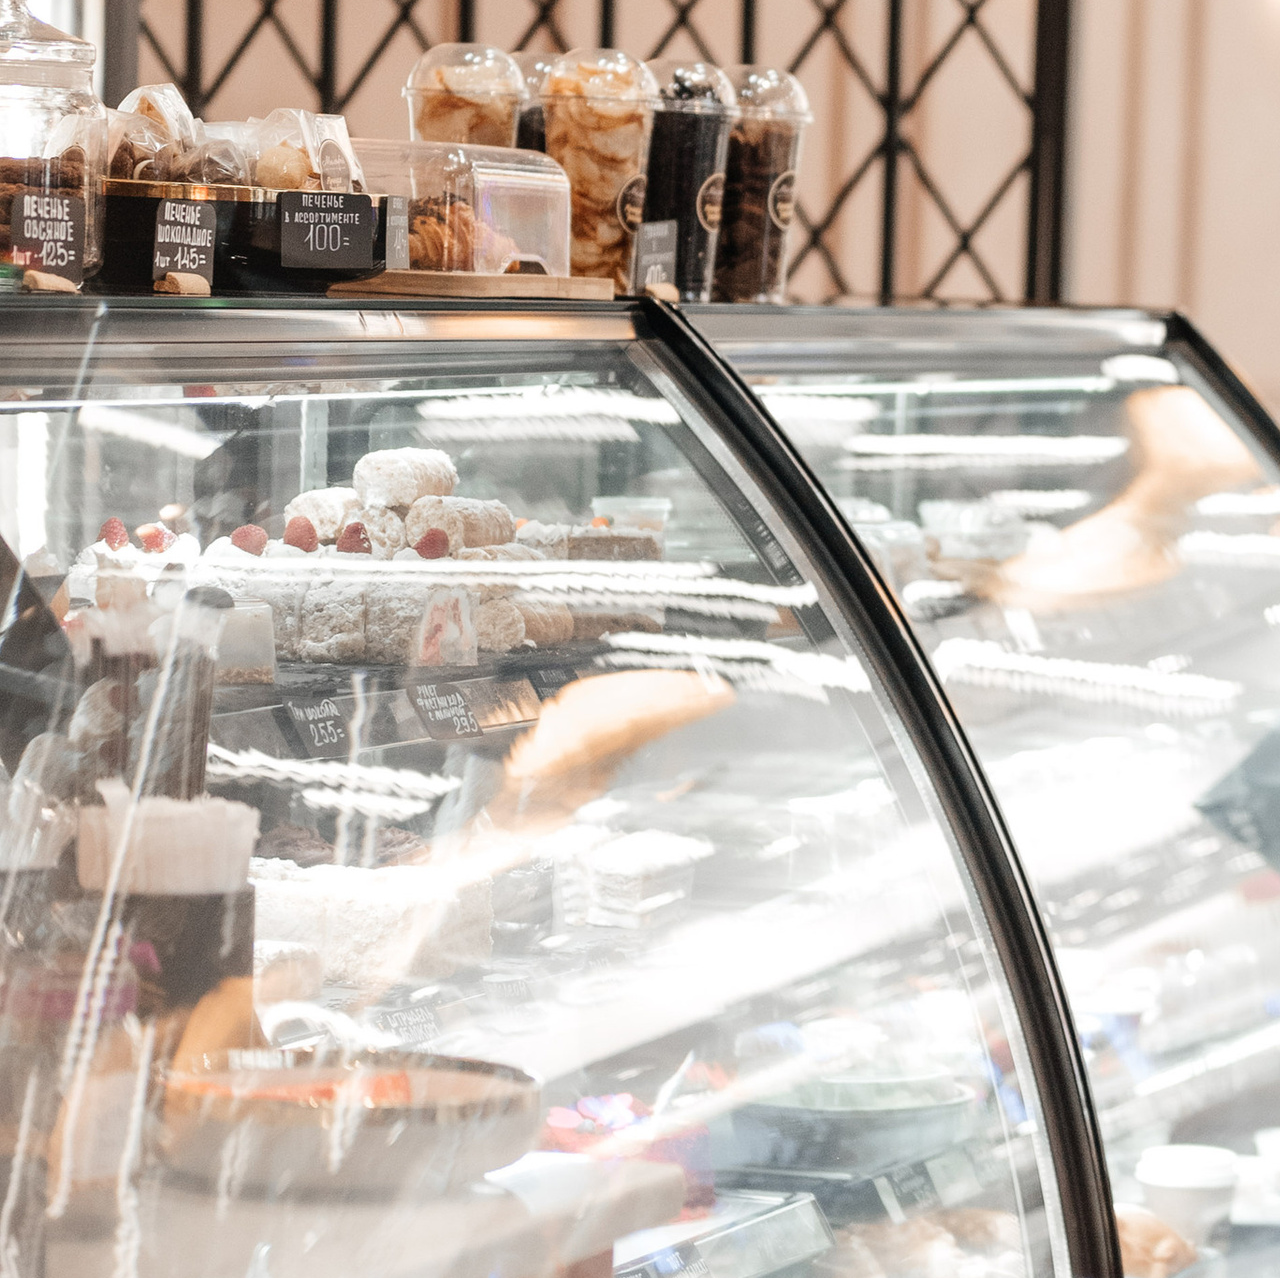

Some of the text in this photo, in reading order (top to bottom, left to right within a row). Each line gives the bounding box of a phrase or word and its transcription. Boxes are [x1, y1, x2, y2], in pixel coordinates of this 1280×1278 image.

[24, 195, 70, 220] ПЕЧЕНЬЕ
[302, 194, 344, 208] ПЕЧЕНЬЕ
[164, 201, 201, 225] ПЕЧЕНЬЕ
[294, 212, 360, 224] АССОРТИМЕНТЕ
[24, 219, 74, 241] ОВСЯНОЕ
[157, 224, 212, 247] ШОКОЛАДНОЕ
[452, 711, 478, 735] 295
